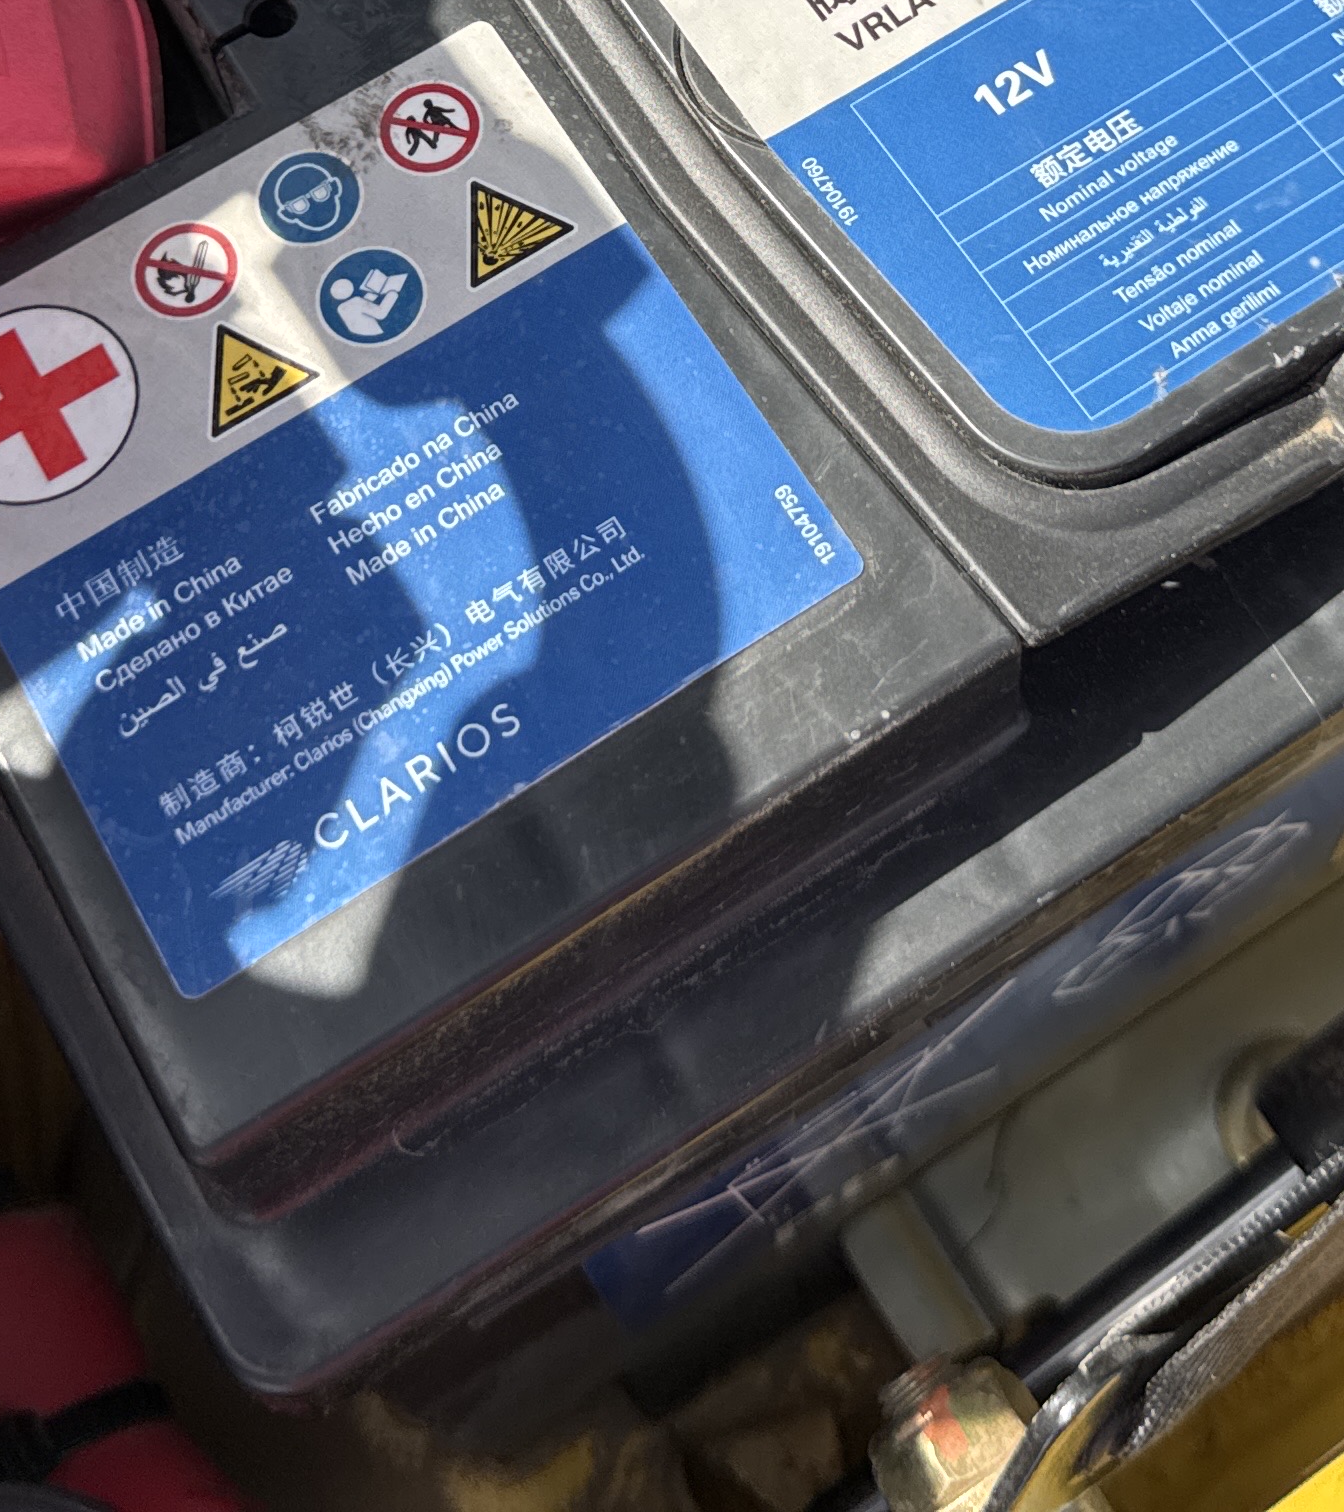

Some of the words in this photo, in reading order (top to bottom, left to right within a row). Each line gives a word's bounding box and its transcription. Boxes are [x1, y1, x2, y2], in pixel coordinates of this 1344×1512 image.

[973, 48, 1055, 116] 12V
[801, 156, 859, 227] 19104760
[1030, 109, 1143, 189] 额定电压
[1038, 170, 1115, 223] Nominal
[1114, 134, 1179, 178] voltage
[1022, 200, 1140, 275] Номинальное
[1139, 139, 1240, 203] напряжение
[1112, 262, 1177, 305] Tensão
[1176, 219, 1242, 268] nominal
[1138, 292, 1199, 333] Voltaje
[1198, 249, 1265, 298] nominal
[1169, 319, 1221, 359] Anma
[1220, 280, 1282, 328] gerilimi
[309, 450, 421, 525] Fabricado
[422, 432, 454, 460] na
[453, 392, 520, 438] China
[327, 503, 403, 555] Hecho
[405, 482, 436, 510] en
[436, 442, 504, 489] China
[345, 539, 412, 587] Made
[410, 523, 438, 547] in
[437, 482, 506, 529] China
[774, 484, 836, 565] 19104759
[55, 536, 185, 621] 中国制造
[76, 612, 146, 663] Made
[144, 598, 172, 622] in
[173, 556, 243, 604] China
[95, 622, 201, 691] Сделано
[204, 610, 222, 630] в
[221, 567, 294, 618] Китае
[237, 623, 288, 670] صنع
[118, 675, 187, 739] الصين
[173, 769, 296, 846] Manufacturer:
[292, 726, 354, 772] Clarios
[352, 661, 454, 738] (Changxing)
[450, 631, 505, 676] Power
[504, 585, 582, 640] Solutions
[579, 569, 616, 593] Co.,
[610, 545, 646, 574] Ltd.
[198, 652, 228, 693] في
[314, 703, 521, 850] CLARIOS
